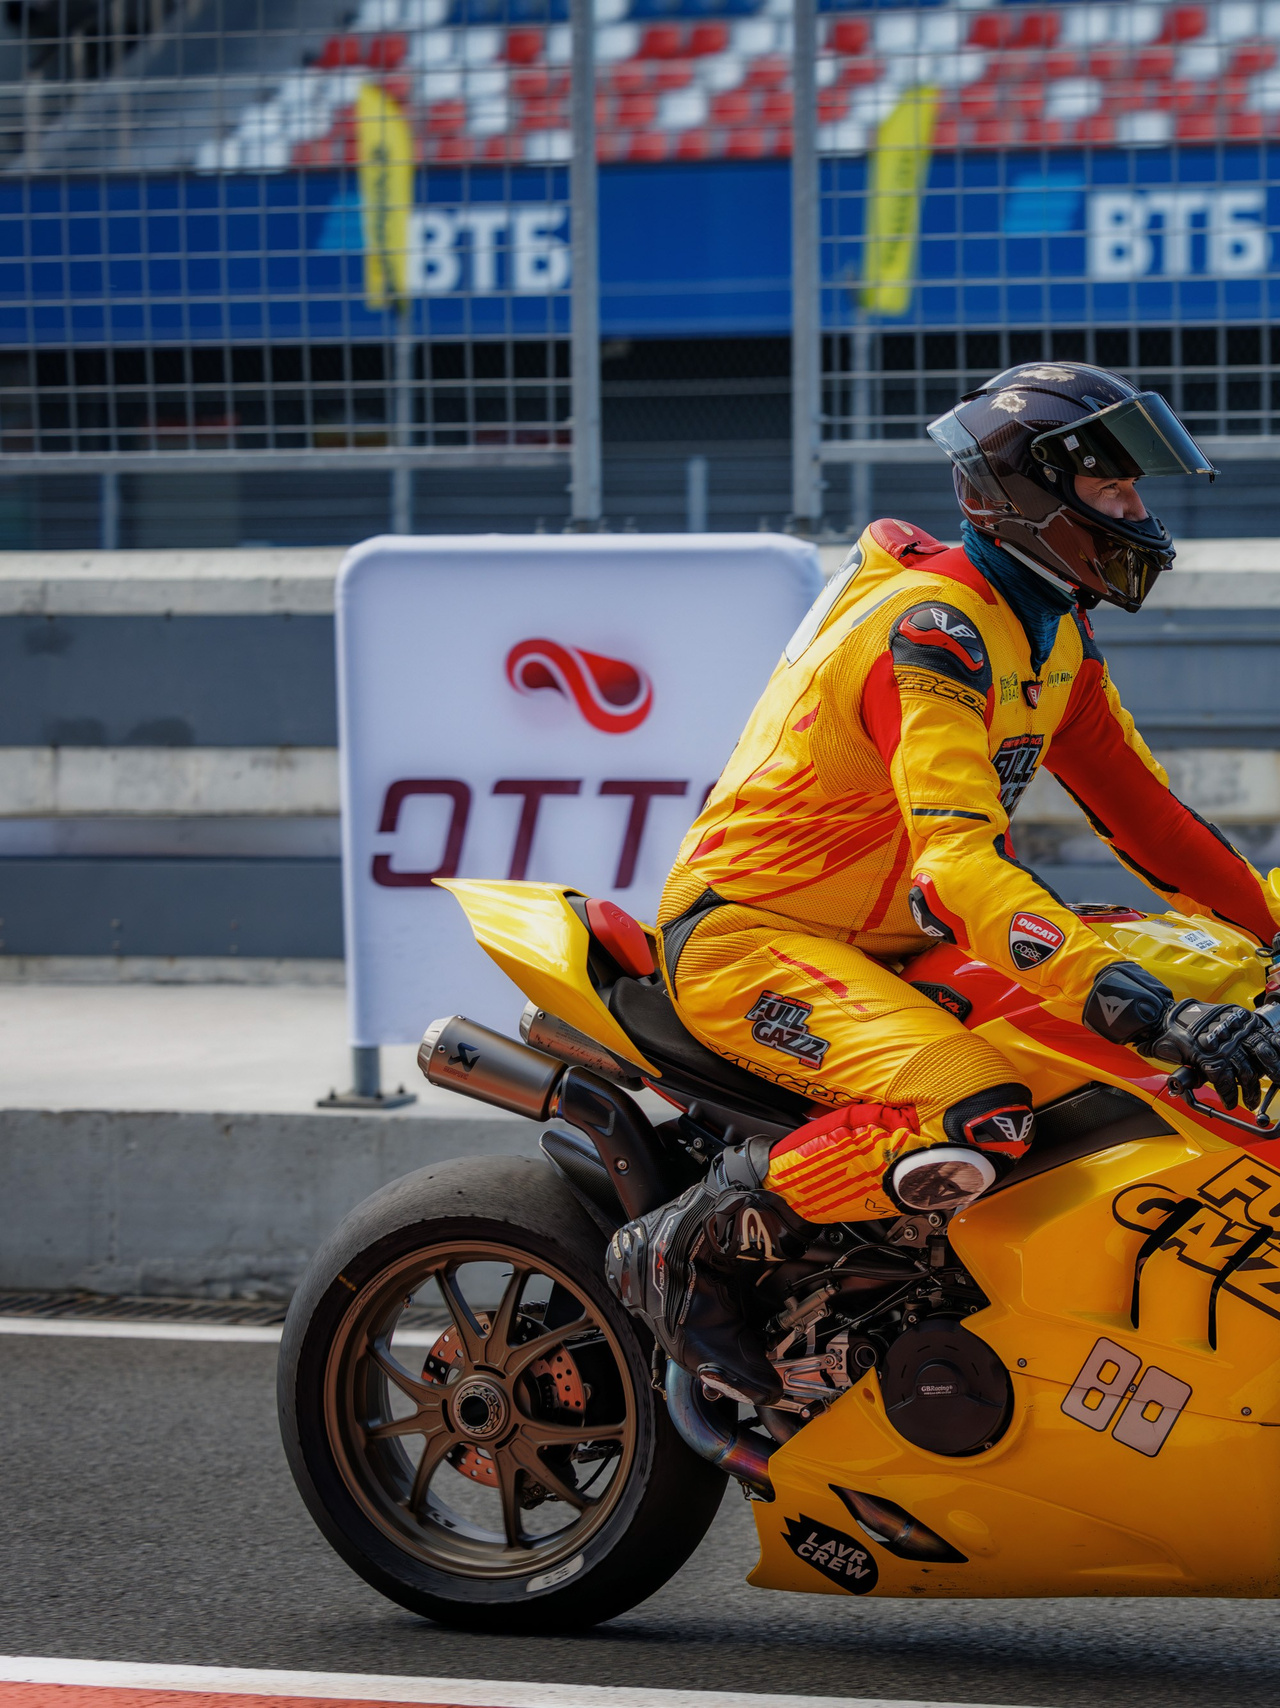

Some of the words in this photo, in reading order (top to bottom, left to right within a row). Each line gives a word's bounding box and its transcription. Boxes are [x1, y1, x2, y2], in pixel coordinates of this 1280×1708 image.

[405, 207, 570, 296] ВТБ
[1087, 189, 1271, 282] ВТБ
[370, 778, 722, 890] OTT
[1017, 917, 1059, 943] DUCATI
[1014, 942, 1042, 962] CORSE
[745, 997, 809, 1034] FULL
[938, 991, 960, 1014] V4
[752, 1020, 831, 1063] GAZZZ
[1060, 1336, 1193, 1458] 80
[797, 1543, 871, 1580] CREW
[805, 1531, 868, 1566] LAVR
